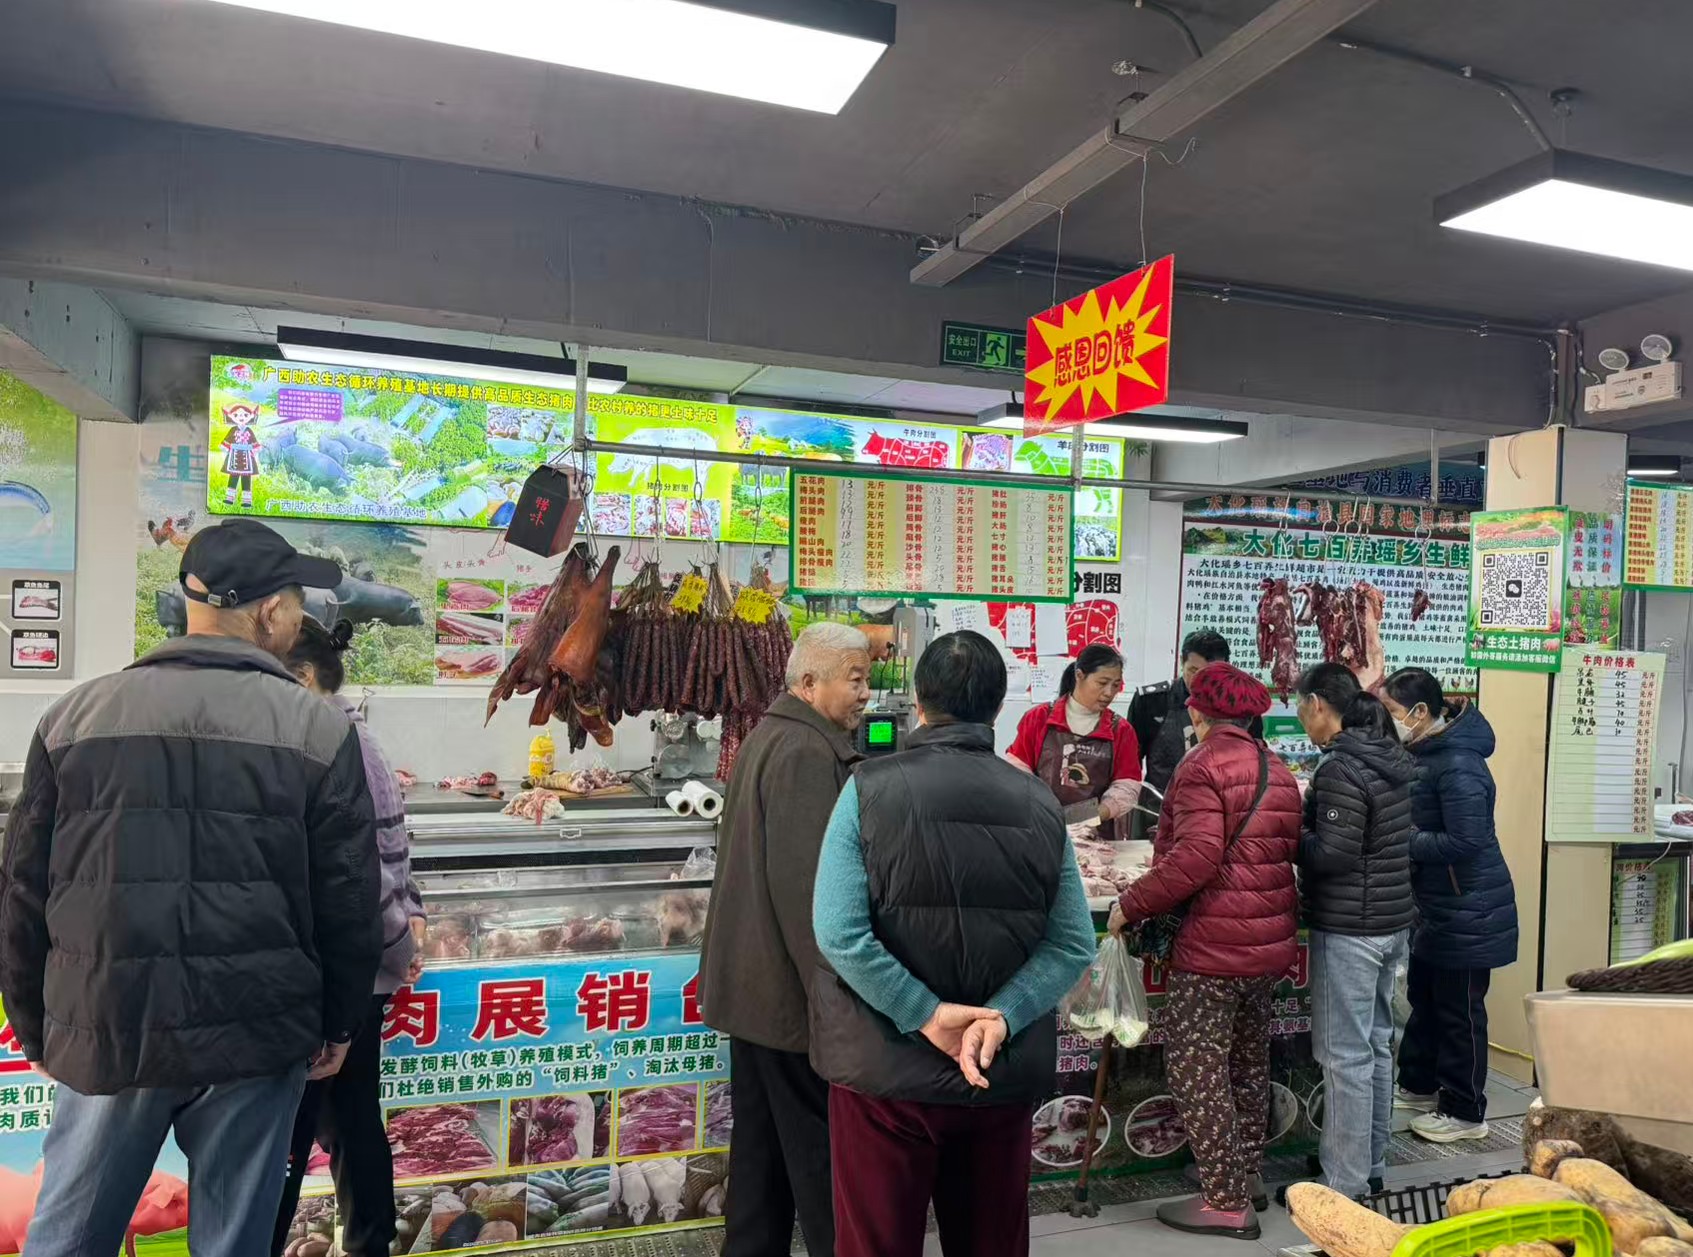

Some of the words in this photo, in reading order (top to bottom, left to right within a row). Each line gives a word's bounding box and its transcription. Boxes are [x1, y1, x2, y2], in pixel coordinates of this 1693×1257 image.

[949, 334, 977, 348] 安全出口
[952, 349, 970, 357] EXIT
[1054, 319, 1135, 388] 感恩回馈
[800, 477, 825, 485] 五花肉
[868, 481, 885, 490] 元/斤
[1306, 467, 1476, 499] 地与消费者垂直
[906, 484, 923, 493] 排骨
[867, 491, 885, 499] 元/斤
[1047, 494, 1064, 502] 元/斤
[867, 501, 884, 509] 元/斤
[957, 497, 974, 505] 元/斤
[1047, 504, 1064, 512] 元/斤
[800, 507, 825, 516] 后腿肉
[867, 511, 884, 519] 元/斤
[1047, 515, 1064, 523] 元/斤
[867, 521, 884, 529] 元/斤
[1047, 525, 1064, 533] 元/斤
[867, 531, 884, 539] 元/斤
[1047, 535, 1064, 543] 元/斤
[957, 536, 974, 544] 元/斤
[867, 541, 884, 549] 元/斤
[957, 546, 974, 554] 元/斤
[1047, 545, 1064, 554] 元/斤
[867, 551, 884, 560] 元/斤
[867, 561, 884, 570] 元/斤
[957, 565, 974, 573] 元/斤
[1047, 567, 1064, 575] 元/斤
[957, 575, 974, 583] 元/斤
[1047, 577, 1064, 585] 元/斤
[1047, 587, 1064, 595] 元/斤
[1486, 635, 1541, 651] 生态土猪肉
[1582, 655, 1636, 668] 牛肉价格表
[1271, 998, 1299, 1015] 十足
